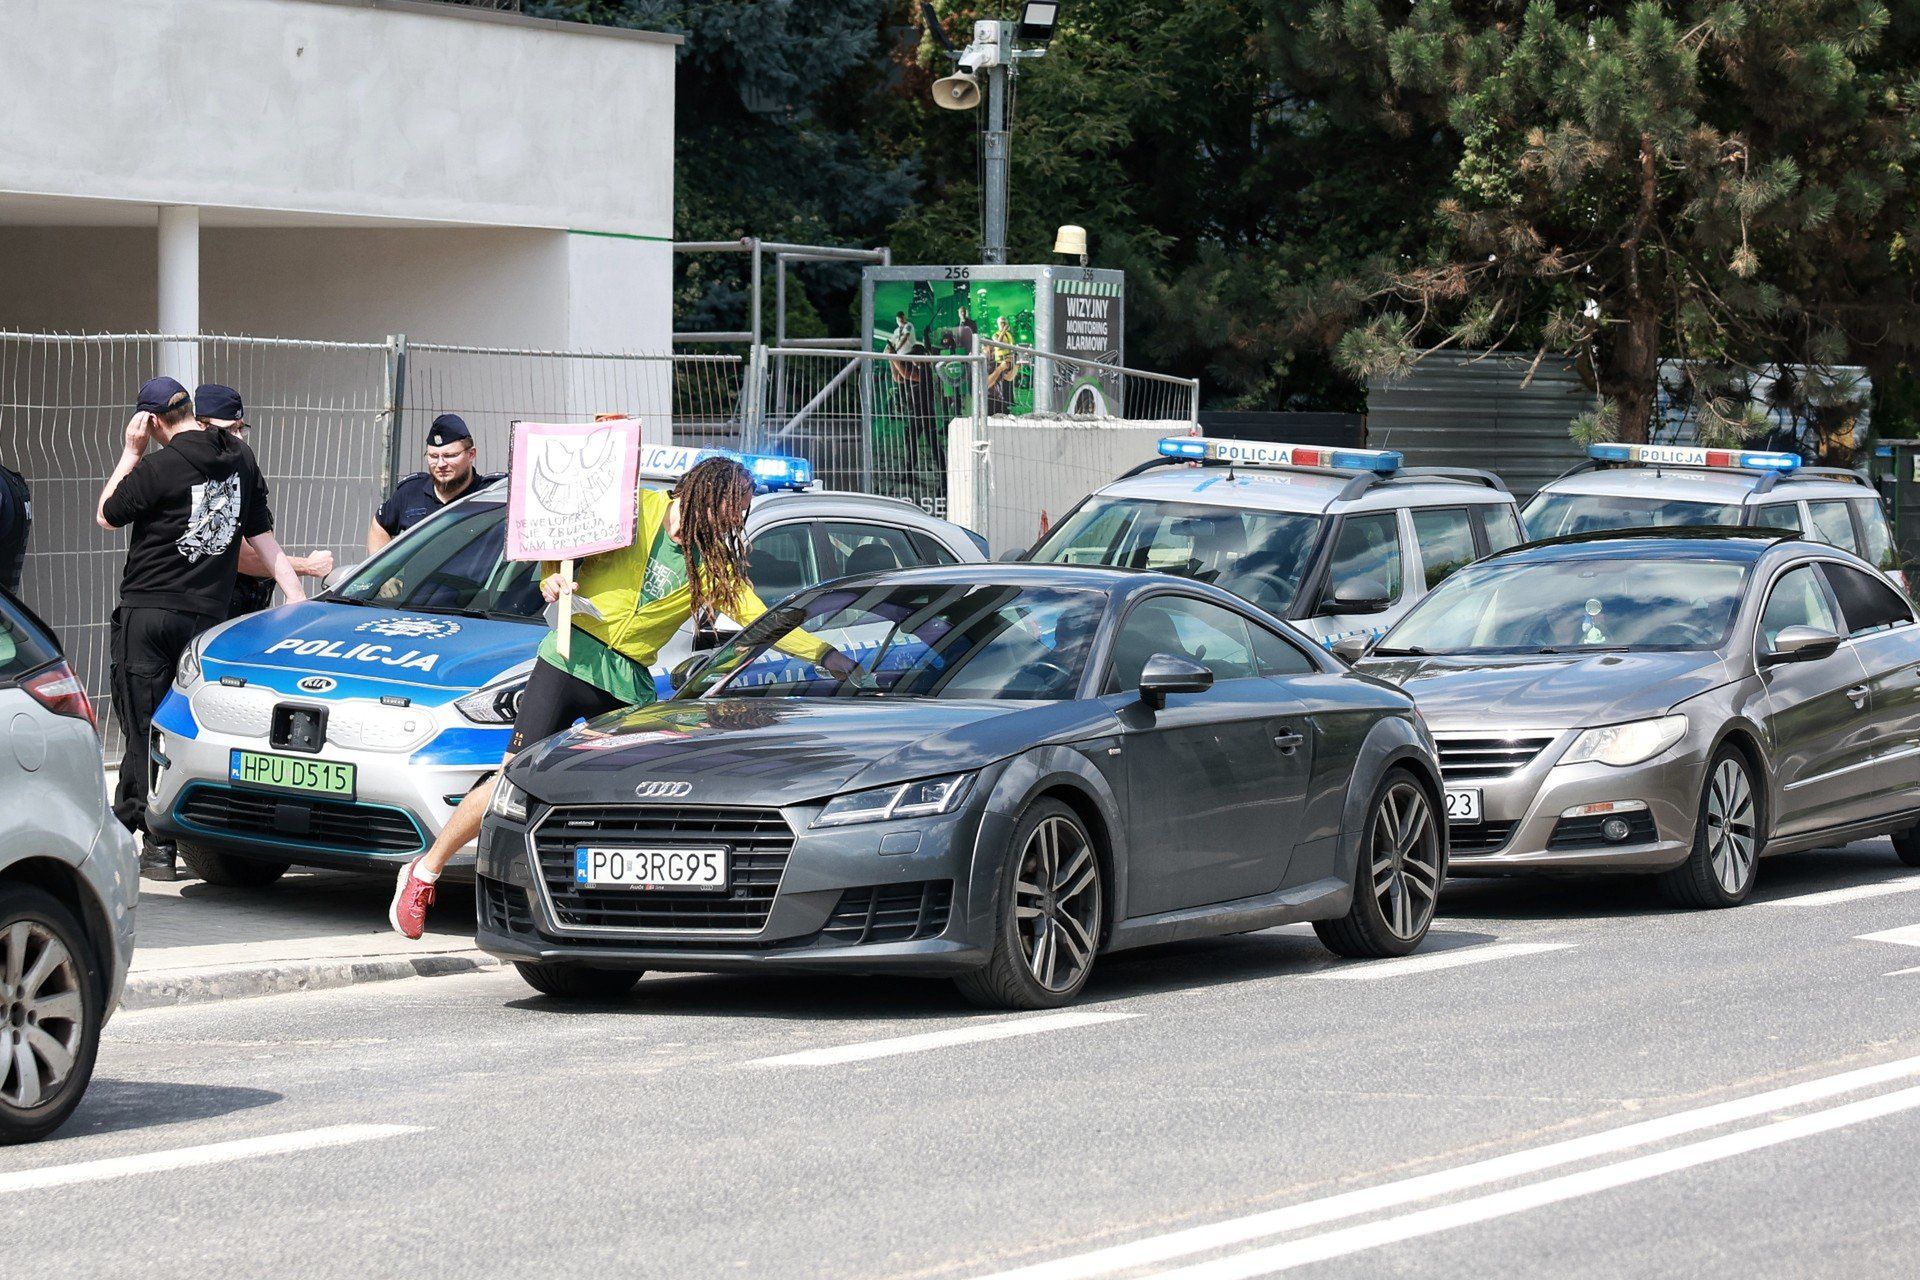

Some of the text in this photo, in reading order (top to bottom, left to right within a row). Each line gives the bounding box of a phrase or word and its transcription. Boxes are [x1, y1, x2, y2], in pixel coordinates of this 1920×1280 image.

[944, 267, 970, 279] 256
[1082, 269, 1094, 281] 256
[1066, 297, 1108, 319] WIZYJNY
[1066, 320, 1108, 335] MONITORING
[1066, 335, 1108, 351] ALARMOWY
[641, 448, 688, 470] ICJA
[1217, 446, 1290, 463] POLICJA
[1640, 450, 1704, 464] POLICJA
[518, 528, 540, 540] NIE
[520, 541, 547, 553] NAM
[650, 557, 671, 578] THE
[264, 639, 440, 672] POLICJA
[303, 678, 328, 690] KIA
[232, 769, 240, 777] PL
[244, 755, 346, 790] HPU D515
[593, 851, 717, 882] PO 3RG95
